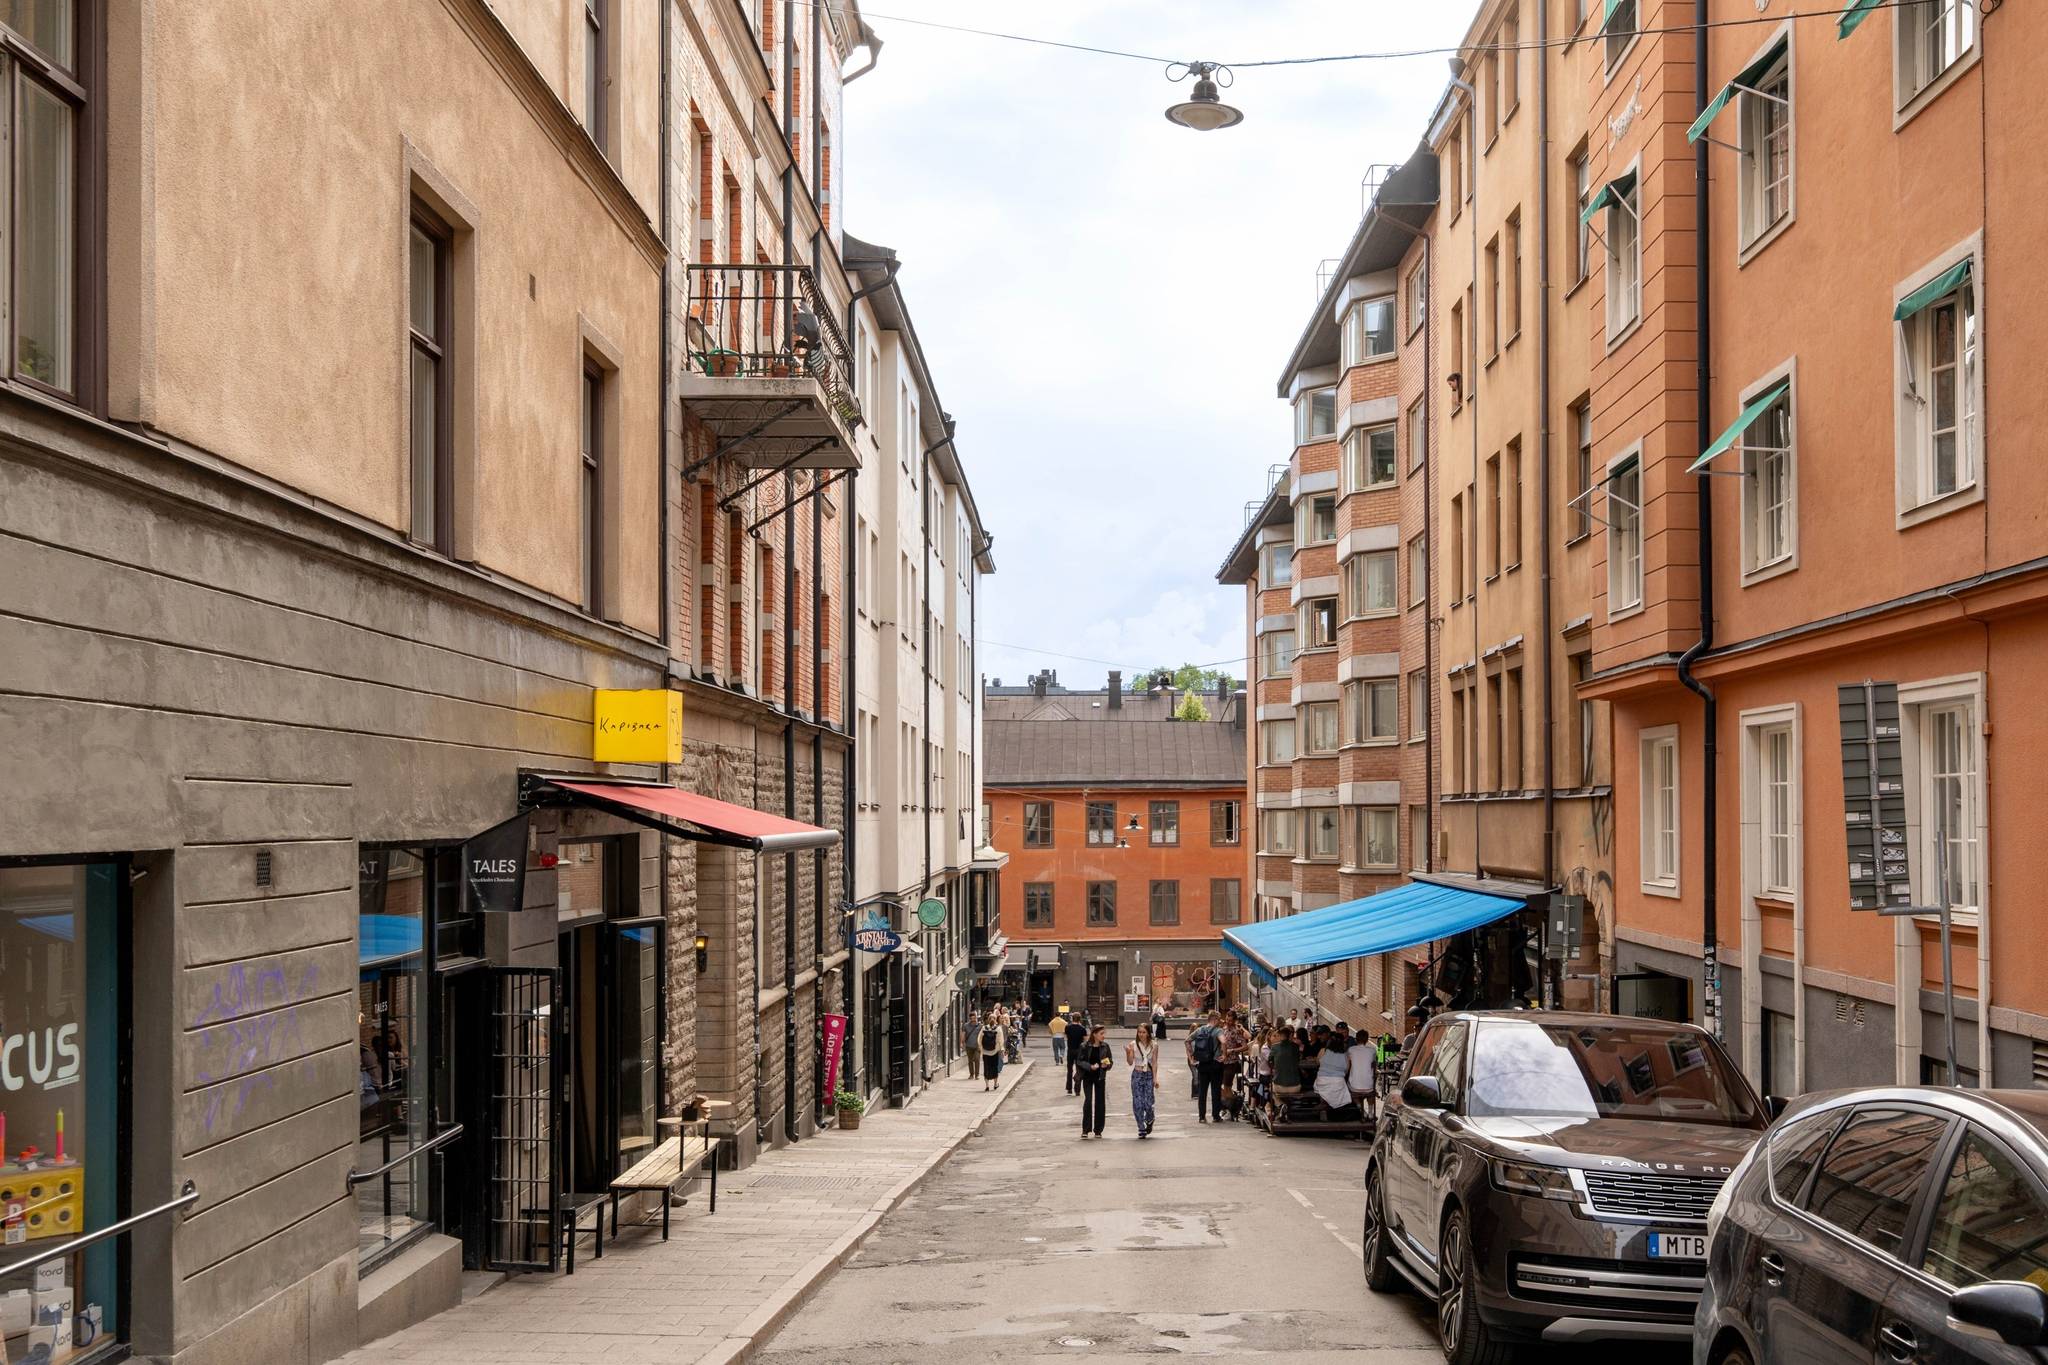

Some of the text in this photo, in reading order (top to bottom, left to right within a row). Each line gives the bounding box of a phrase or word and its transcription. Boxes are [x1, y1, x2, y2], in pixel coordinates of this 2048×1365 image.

[473, 859, 516, 873] TALES
[855, 931, 888, 946] KRISTALL
[2, 1022, 80, 1091] CUS
[1601, 1160, 1685, 1171] RANGE
[1666, 1236, 1705, 1256] MTB
